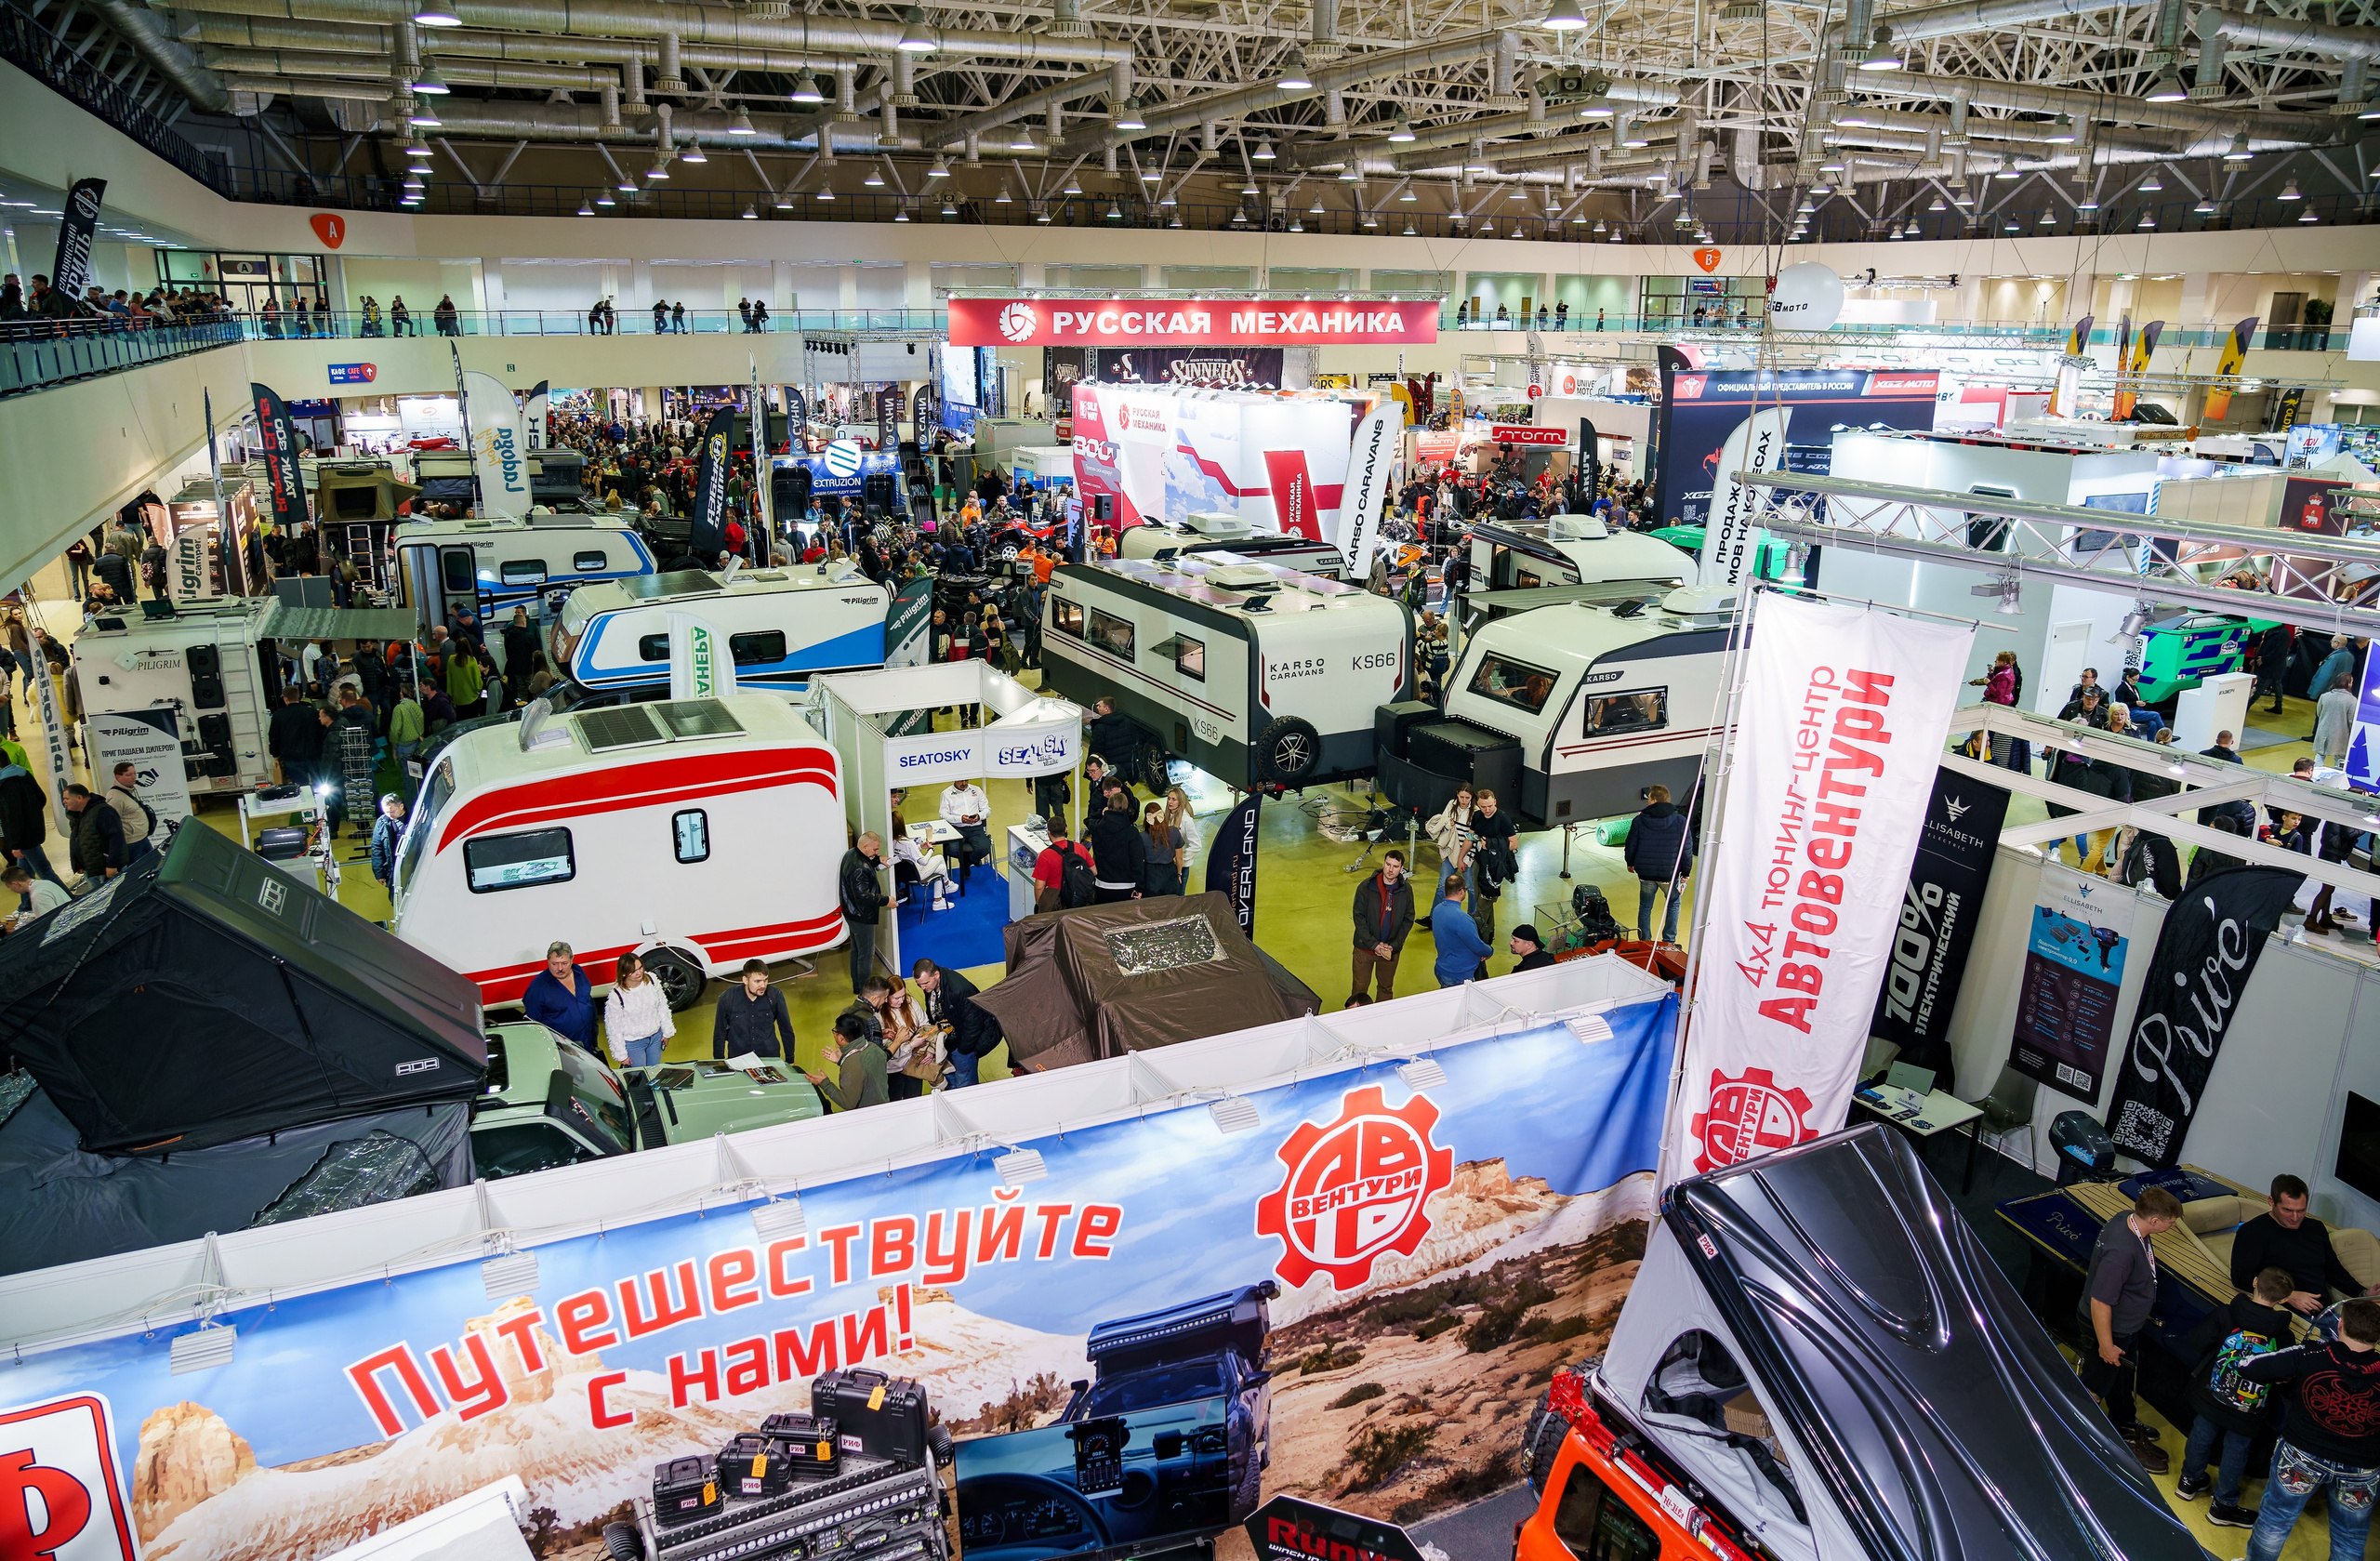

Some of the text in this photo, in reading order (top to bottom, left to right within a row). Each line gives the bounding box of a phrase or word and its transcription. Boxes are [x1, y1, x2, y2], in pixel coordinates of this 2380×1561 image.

[59, 222, 78, 292] СЛАВЯНСКИЙ
[65, 233, 91, 303] ГРИЛЬ
[1052, 310, 1406, 336] РУССКАЯ МЕХАНИКА
[1170, 359, 1246, 385] SINNERS
[1577, 379, 1597, 388] UNIVE
[1717, 381, 1771, 392] ОФИЦИАЛЬНЫЙ
[1772, 382, 1822, 391] ПРЕДСТАВИТЕЛЬ
[1828, 382, 1854, 390] РОССИИ
[1905, 379, 1937, 388] MOTO
[885, 398, 895, 433] САНИ
[918, 397, 927, 431] САНИ
[1132, 407, 1160, 418] РУССКАЯ
[1132, 419, 1167, 432] МЕХАНИКА
[813, 477, 862, 487] EXTRUZION
[1348, 419, 1383, 573] KARSO CARAVANS
[1715, 483, 1742, 563] ПРОДАЖ
[850, 595, 879, 605] Piligrim
[898, 592, 930, 625] Piligrim
[137, 659, 180, 671] PILIGRIM
[1270, 657, 1326, 673] KARSO
[1352, 652, 1395, 671] KS66
[1270, 668, 1326, 681] CARAVANS
[1587, 671, 1618, 683] KARSO
[112, 726, 150, 737] Piligrim
[1193, 717, 1219, 741] KS66
[101, 744, 176, 759] ПРИГЛАШАЕМ ДИЛЕРОВ!
[899, 748, 972, 768] SEATOSKY
[1170, 774, 1194, 785] KARSO
[1922, 817, 1984, 849] LLISABETH
[1238, 809, 1256, 927] OVERLAND
[2063, 894, 2103, 914] ELLISABETH
[1884, 882, 1943, 1025] 100%
[2037, 938, 2061, 952] Лодочный
[2132, 895, 2251, 1117] Privé
[1291, 1168, 1422, 1220] ВЕНТУРИ
[2046, 1210, 2082, 1241] Privé
[1699, 1235, 1717, 1259] РИФ
[346, 1185, 1122, 1440] Путешествуйте
[588, 1282, 914, 1430] с нами!
[791, 1445, 806, 1453] РИФ
[843, 1438, 861, 1449] РИФ
[743, 1481, 761, 1489] РИФ
[681, 1500, 697, 1508] РИФ
